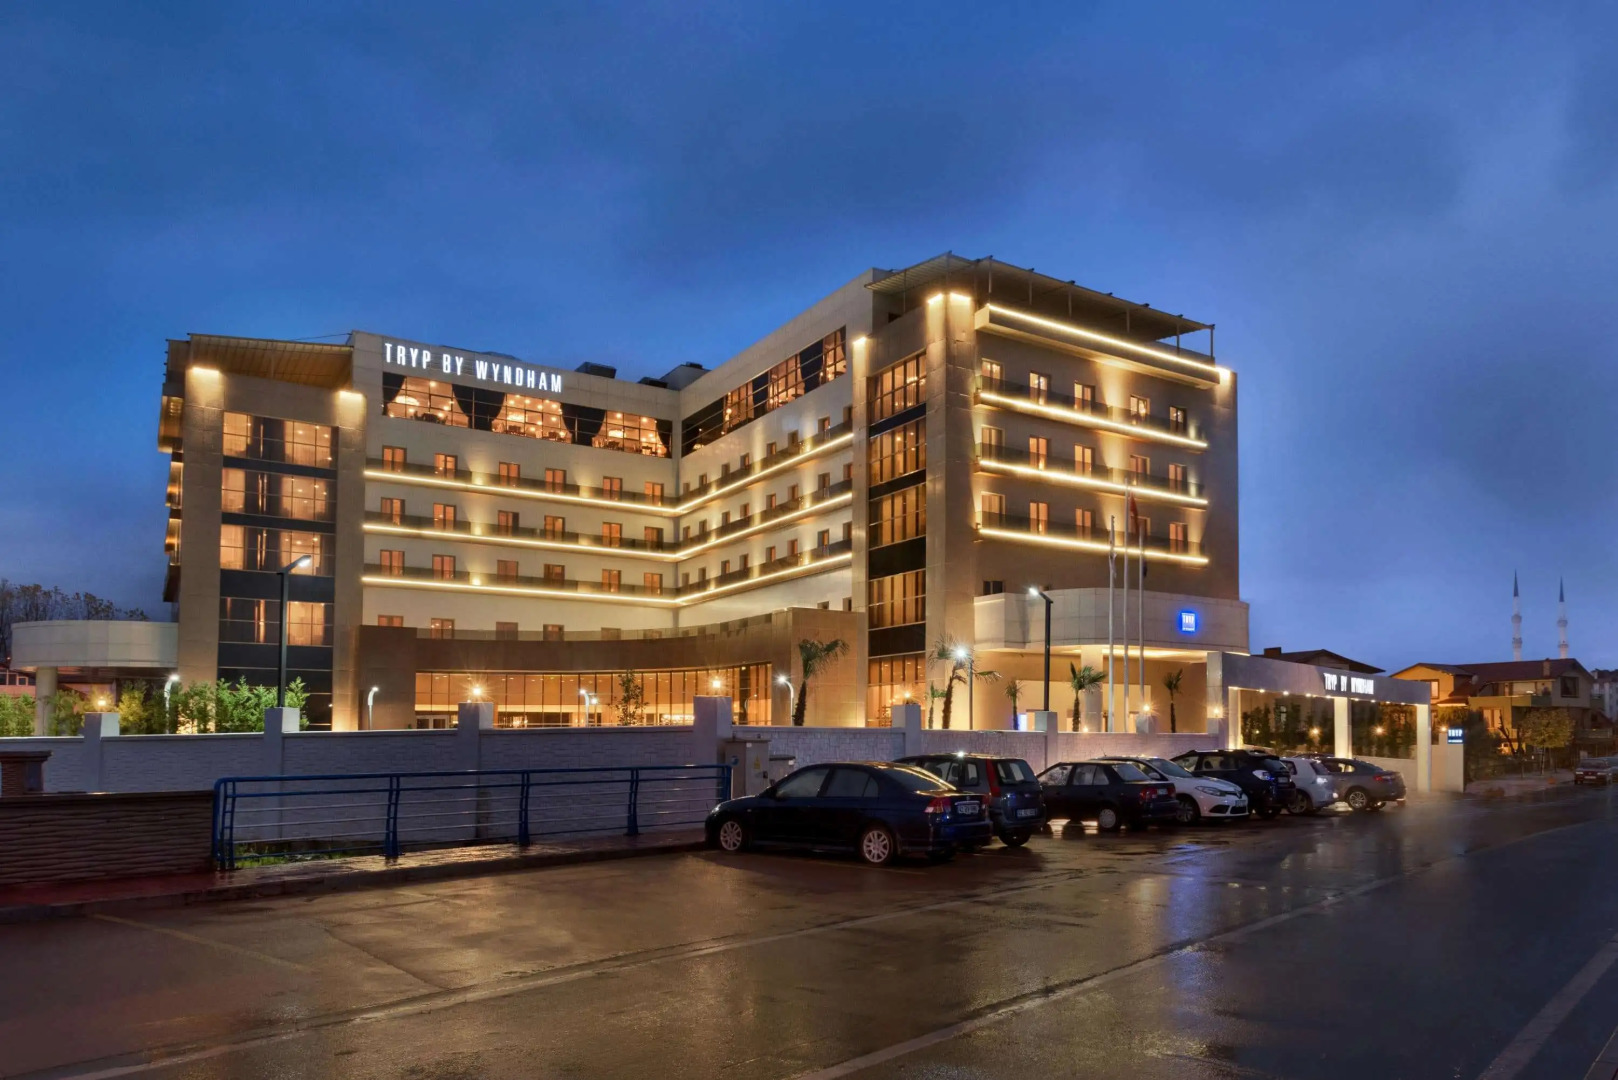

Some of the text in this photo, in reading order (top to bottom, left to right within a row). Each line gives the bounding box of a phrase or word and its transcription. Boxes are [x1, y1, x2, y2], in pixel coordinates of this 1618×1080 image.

[384, 343, 562, 392] TRYP BY WYNDHAM
